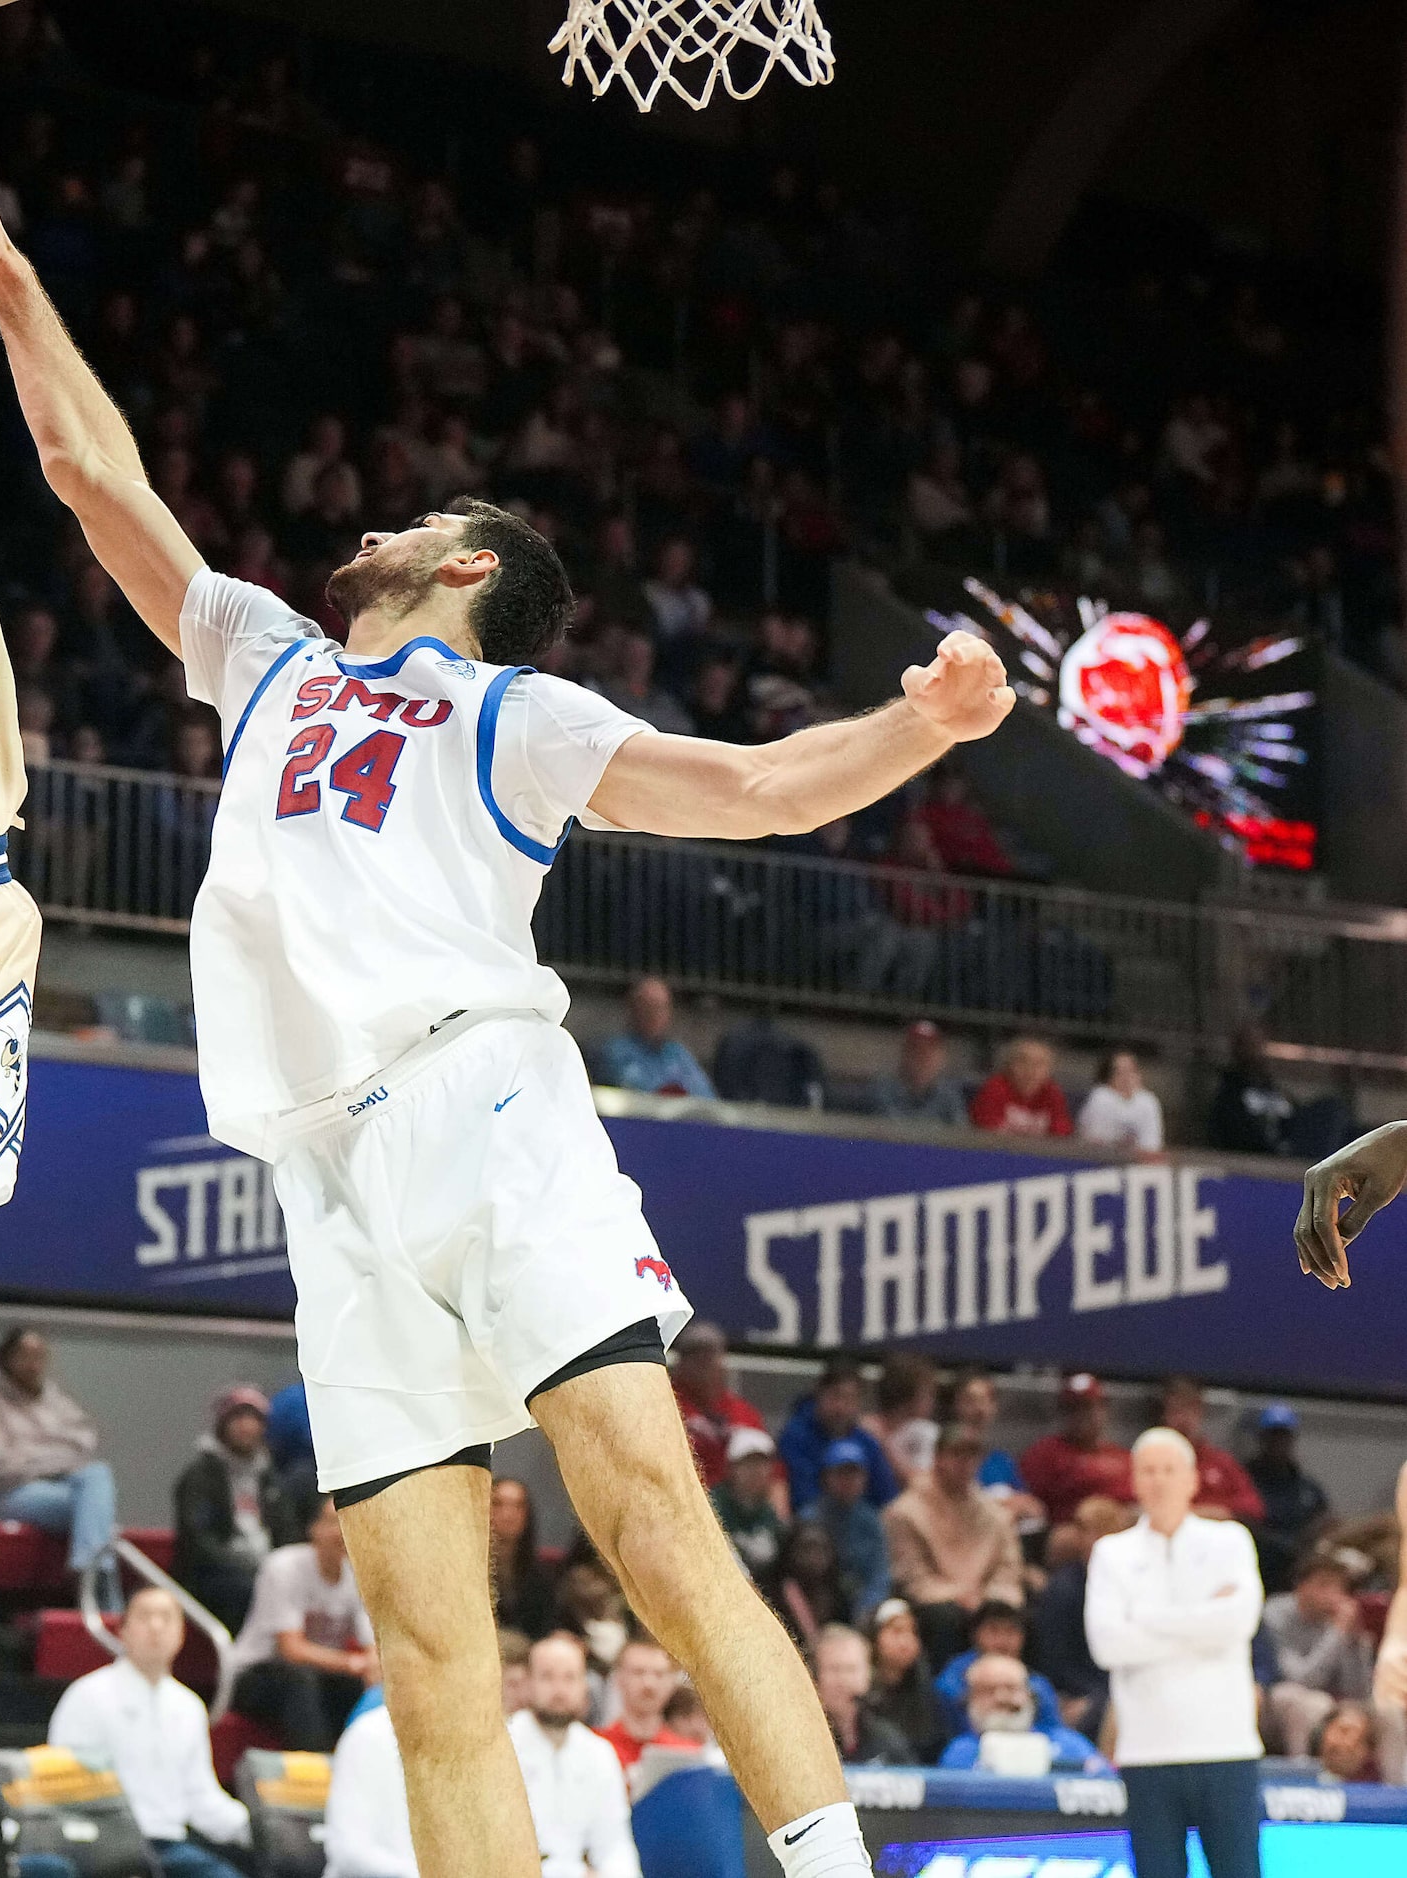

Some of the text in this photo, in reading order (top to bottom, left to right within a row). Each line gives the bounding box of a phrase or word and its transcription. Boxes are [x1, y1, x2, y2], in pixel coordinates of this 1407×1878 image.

[290, 674, 454, 728] SMU
[276, 723, 407, 833] 24
[347, 1085, 390, 1117] SMU
[744, 1163, 1230, 1348] STAMPEDE
